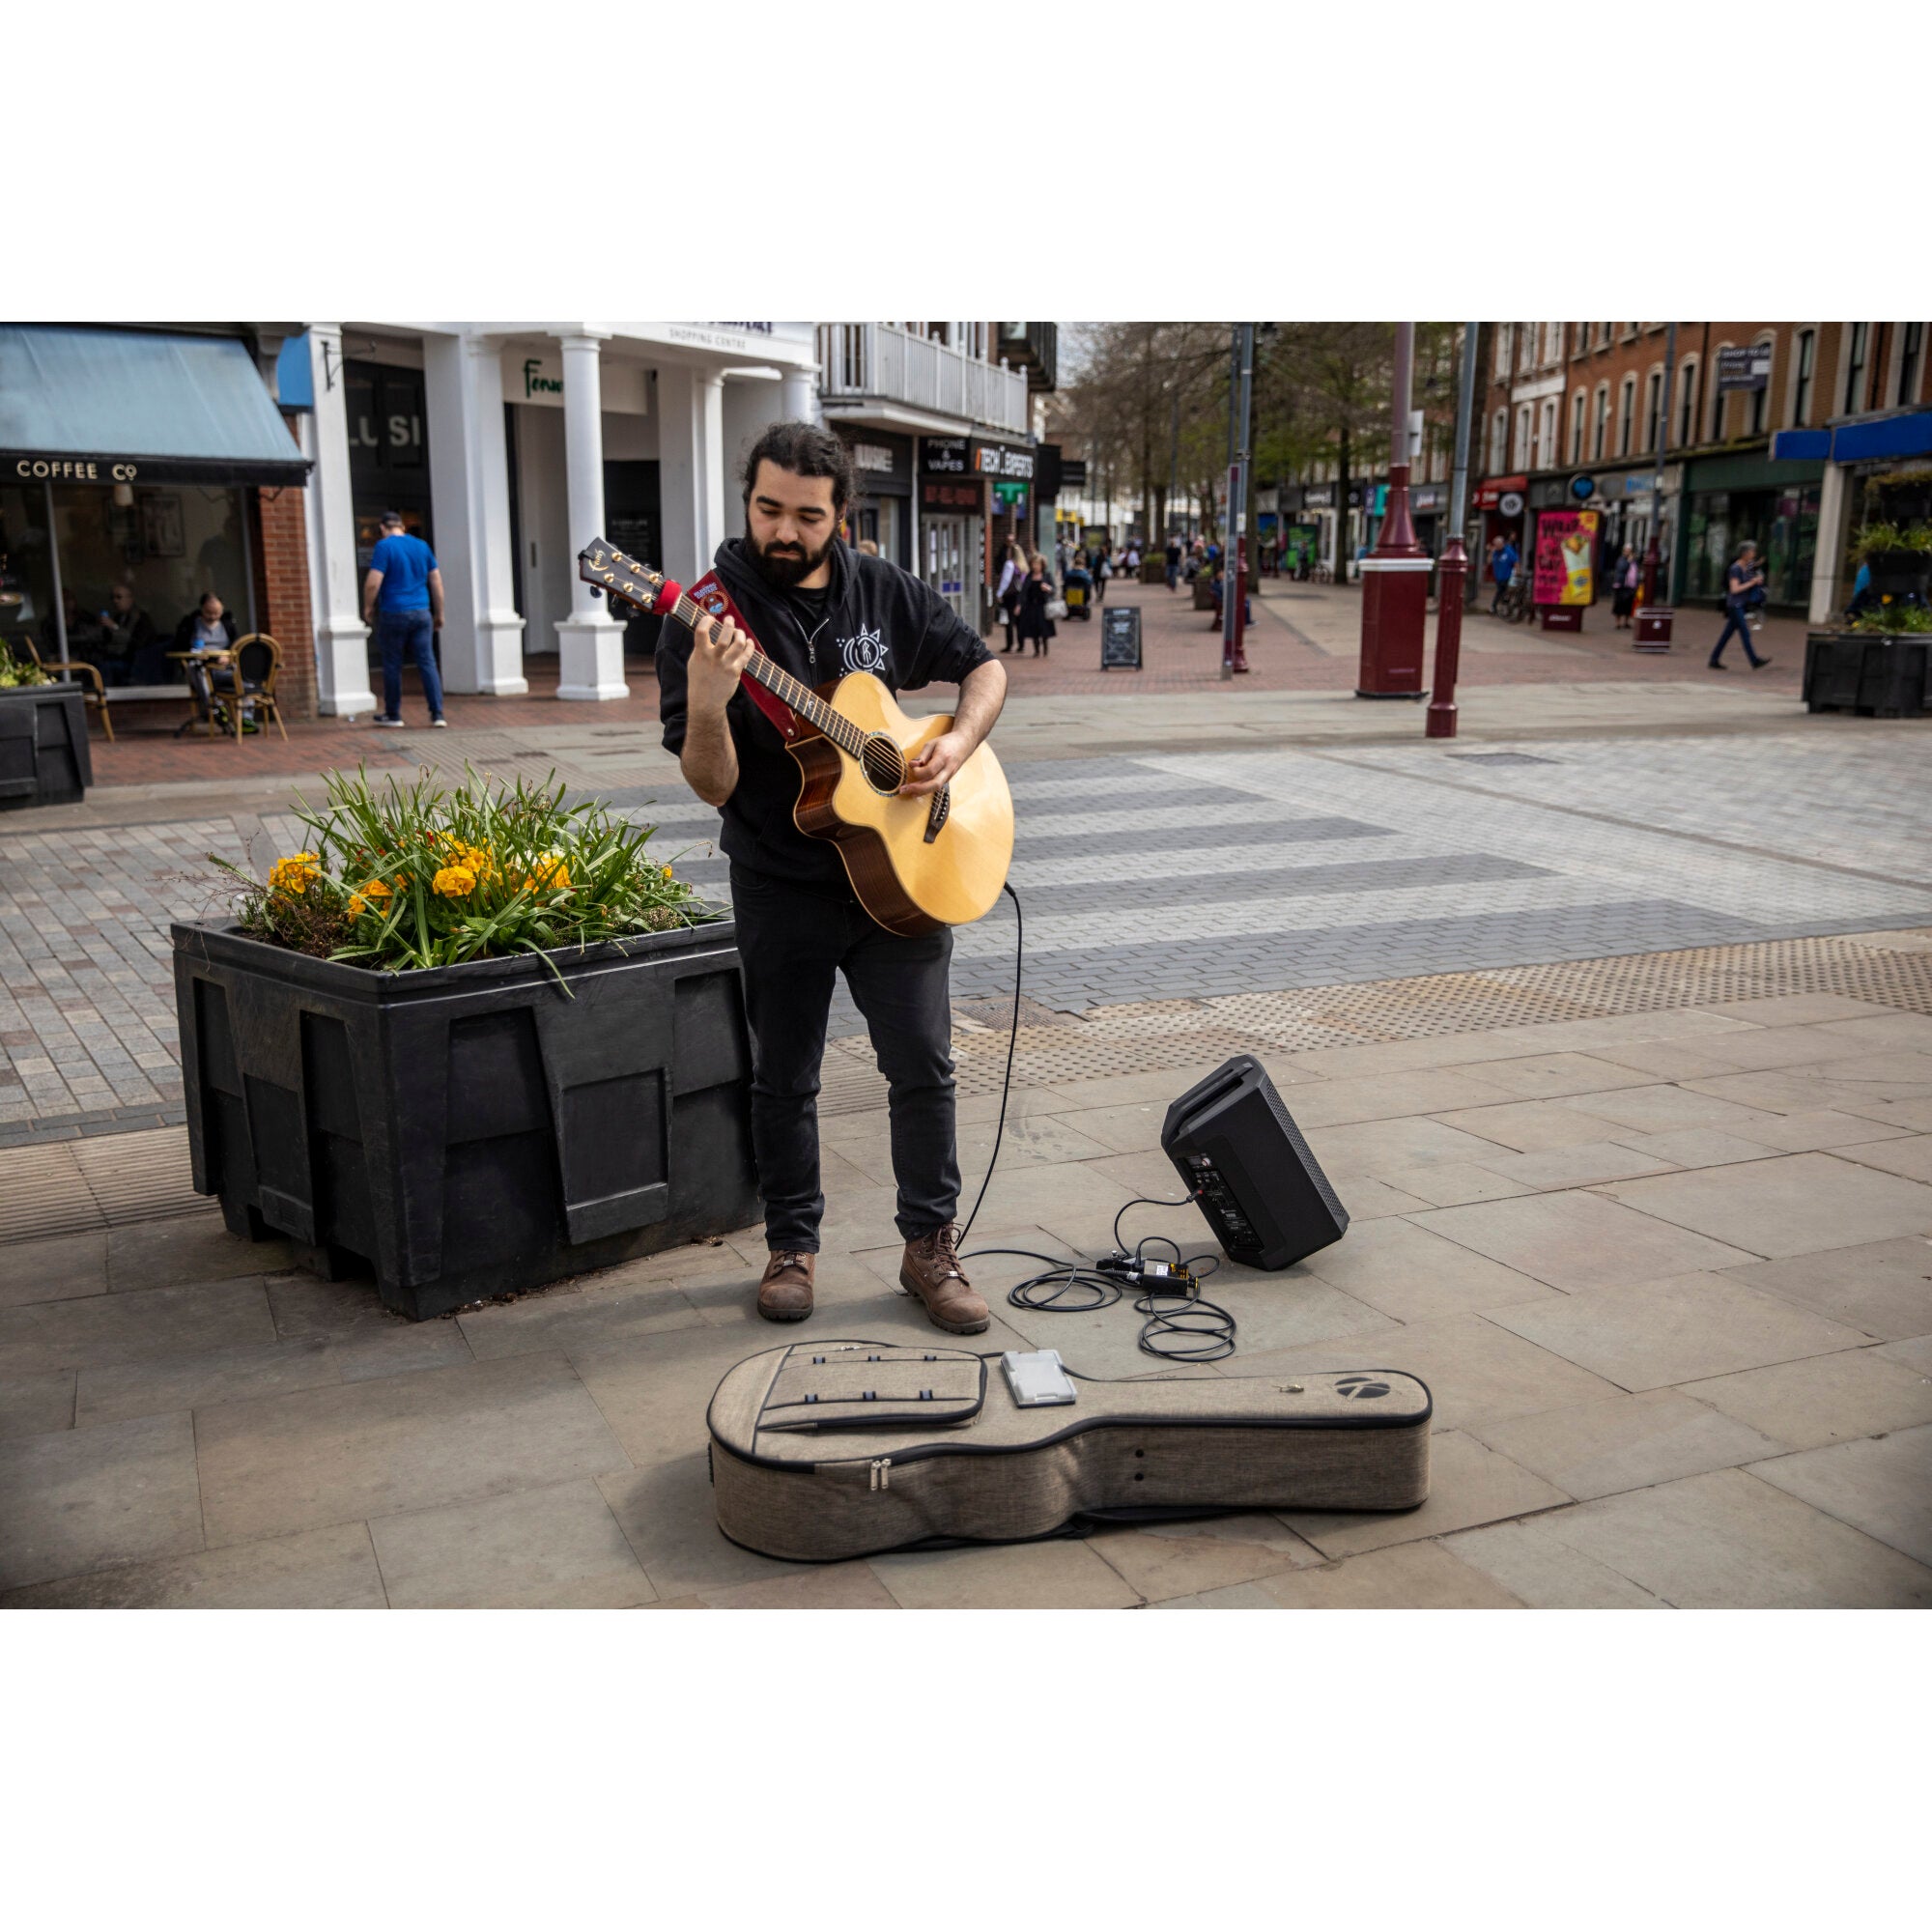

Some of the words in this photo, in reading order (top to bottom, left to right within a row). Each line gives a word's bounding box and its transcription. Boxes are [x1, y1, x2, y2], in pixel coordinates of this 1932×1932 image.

[927, 439, 965, 450] PHONE
[16, 460, 98, 479] COFFEE
[928, 460, 964, 471] VAPES
